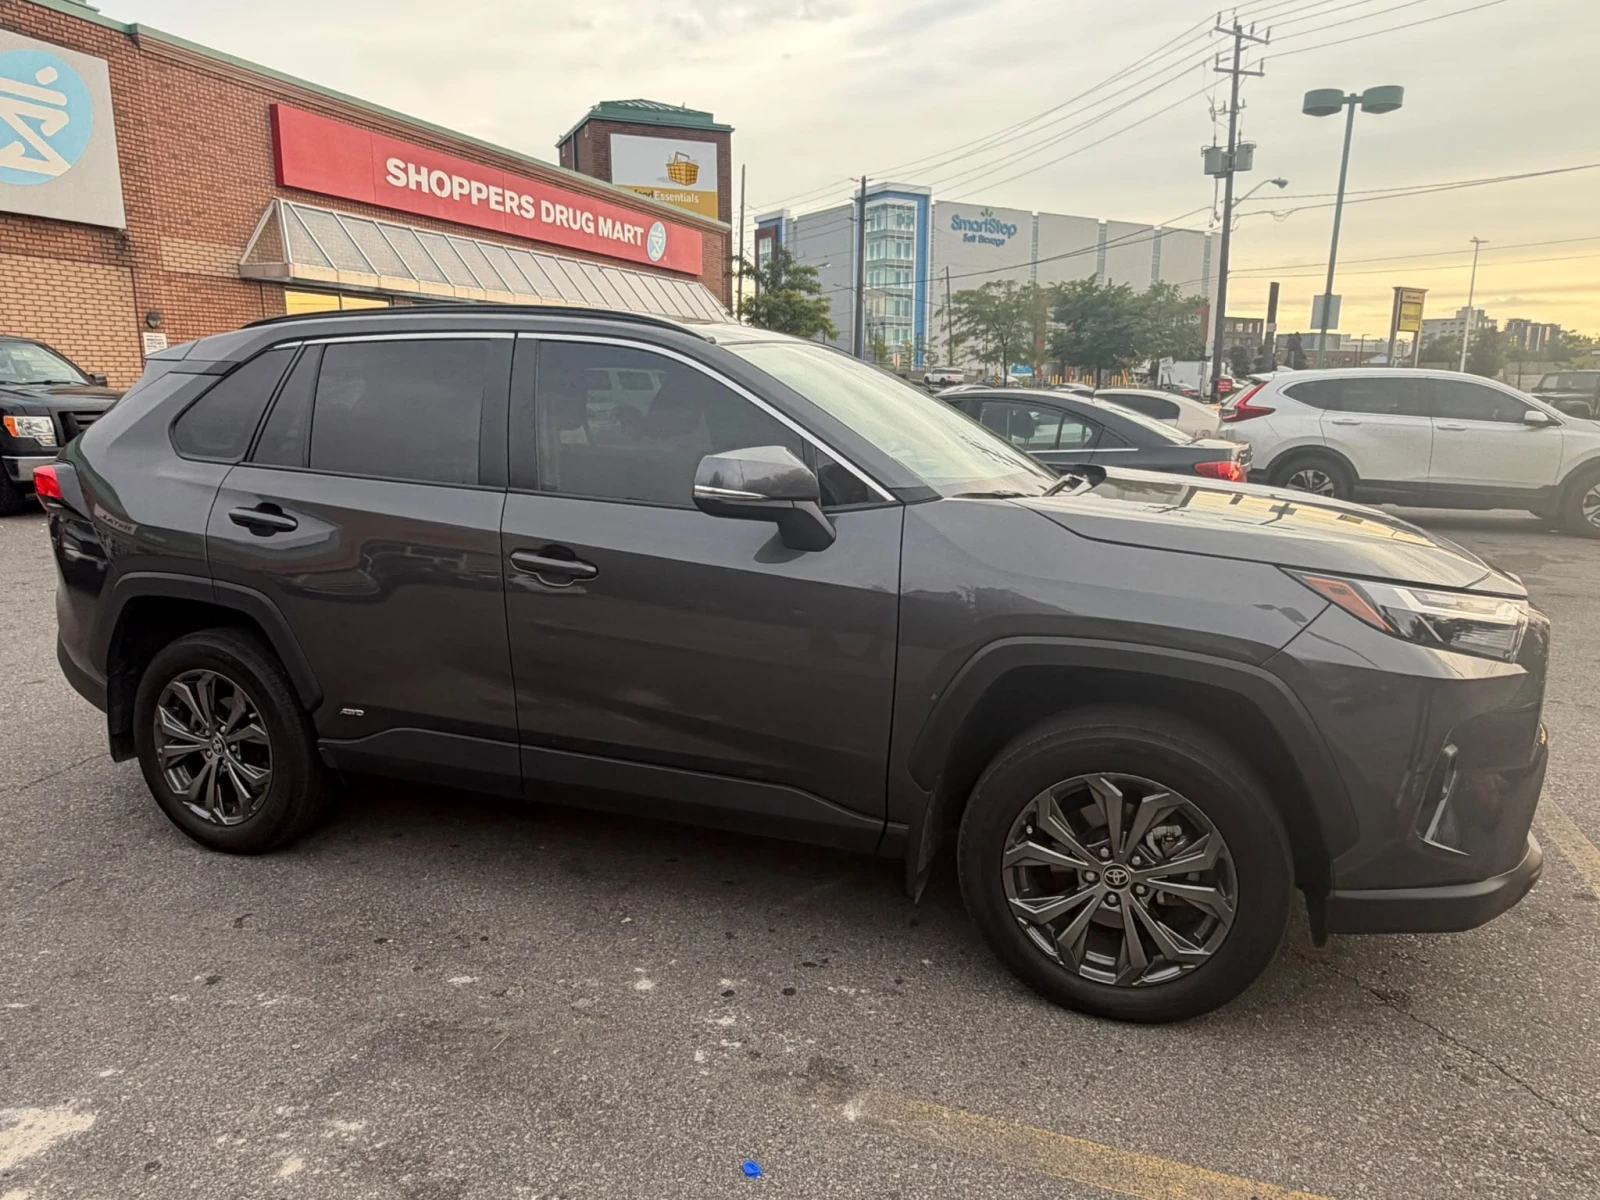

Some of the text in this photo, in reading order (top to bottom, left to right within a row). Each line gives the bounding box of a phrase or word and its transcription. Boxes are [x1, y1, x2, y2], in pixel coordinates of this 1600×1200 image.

[385, 157, 645, 246] SHOPPERS DRUG MART
[654, 190, 700, 204] Essentials
[951, 214, 1017, 239] SmartStop
